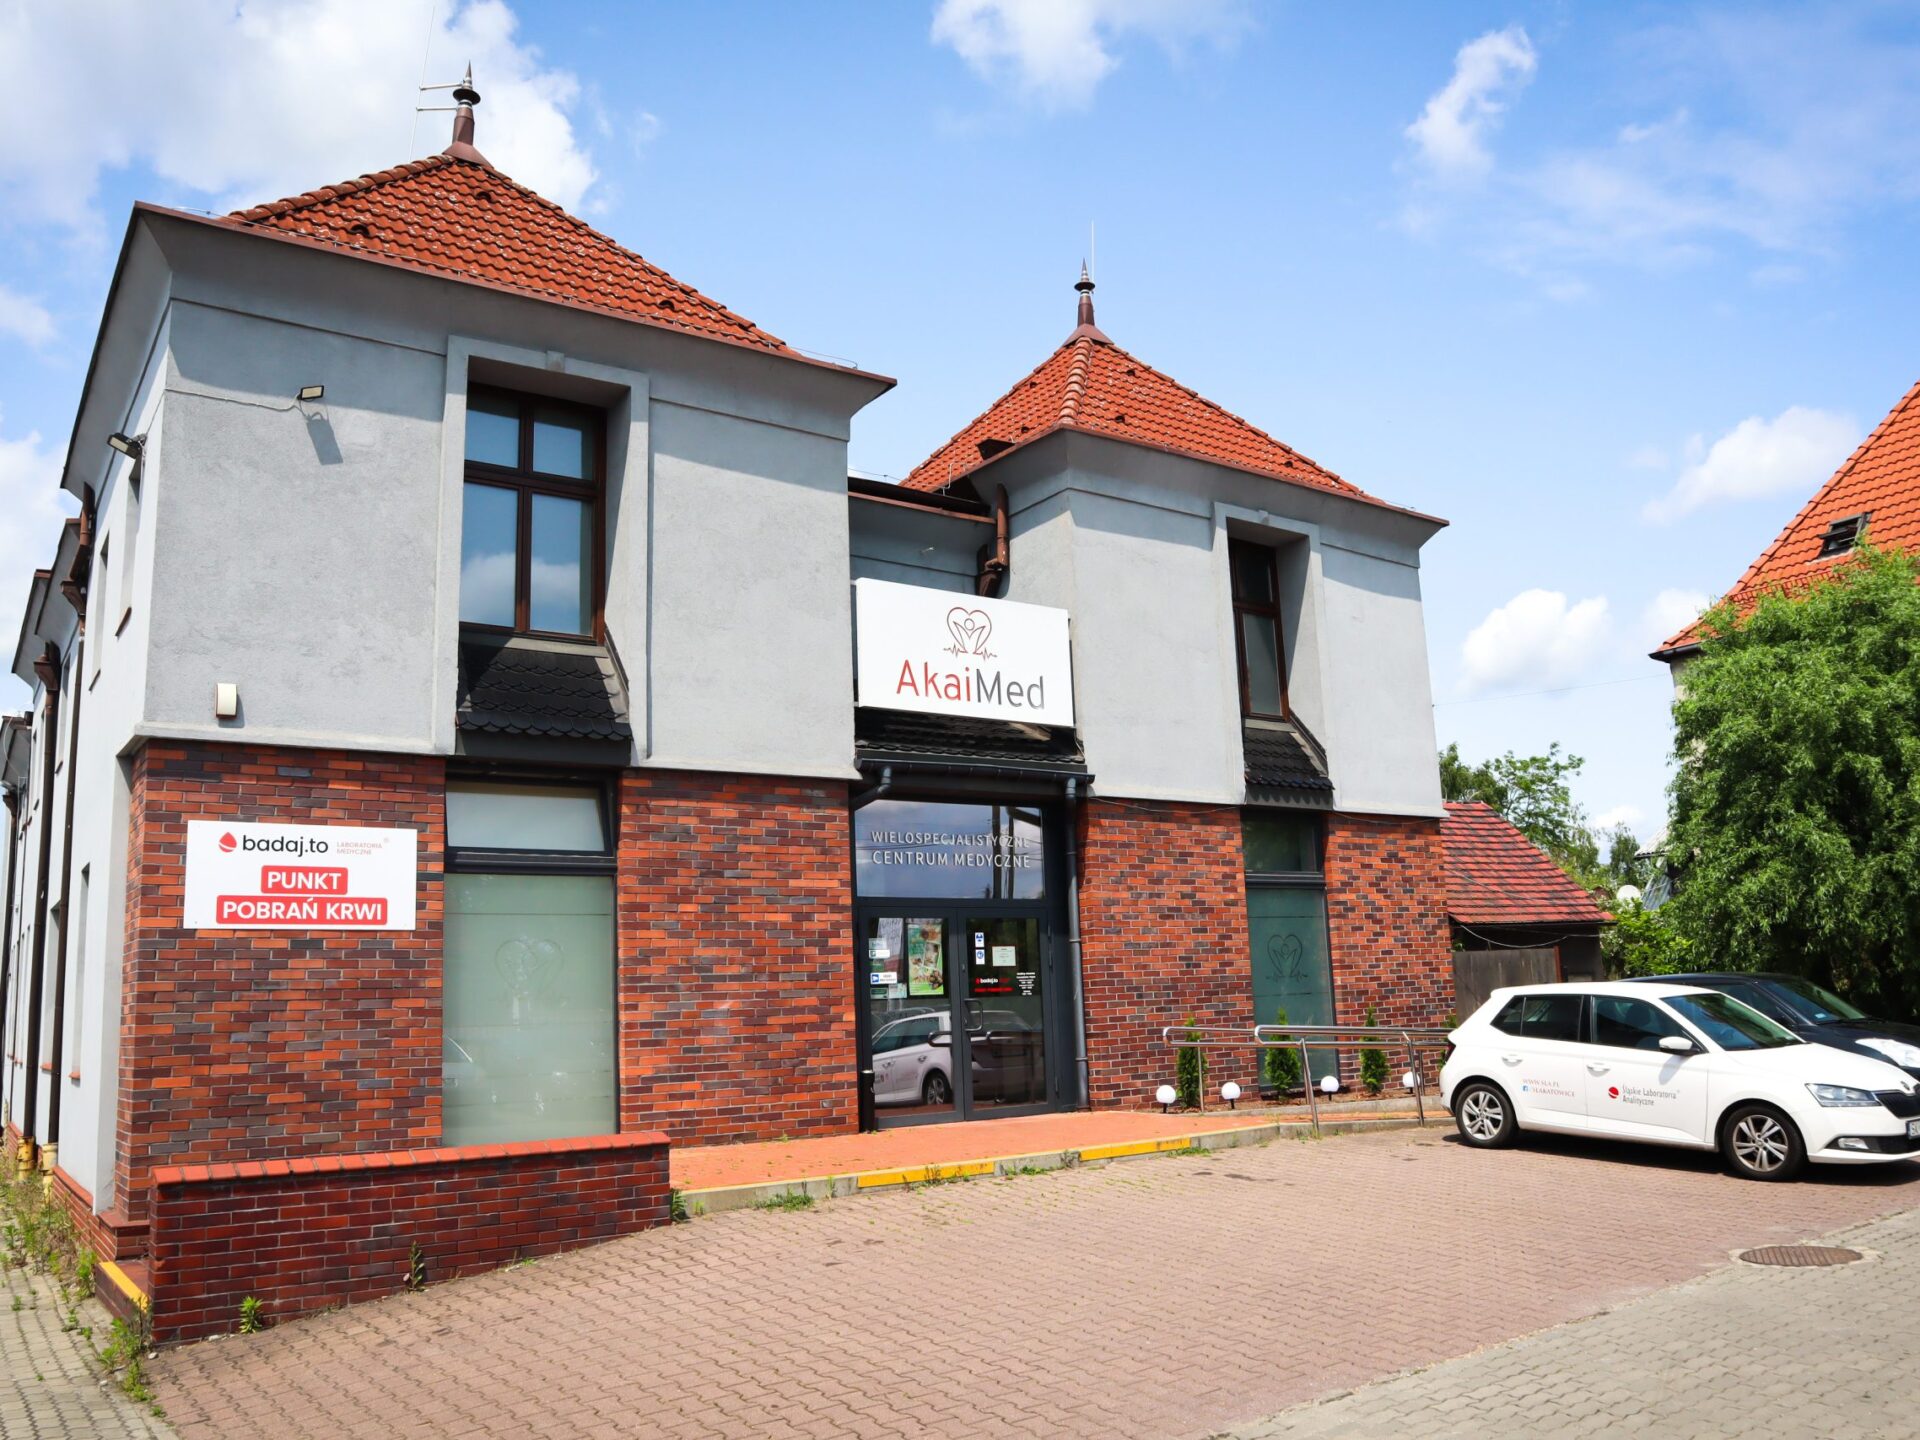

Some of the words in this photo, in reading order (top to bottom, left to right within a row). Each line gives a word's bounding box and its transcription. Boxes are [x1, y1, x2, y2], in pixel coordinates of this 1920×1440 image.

[896, 659, 1045, 710] AkaiMed
[242, 834, 329, 857] badaj.to
[336, 841, 383, 849] LABORATORIA
[871, 831, 1030, 848] WIELOSPECJALISTYCZNE
[872, 850, 948, 866] CENTRUM
[954, 853, 1031, 868] MEDYCZNE
[267, 871, 342, 890] PUNKT
[222, 897, 318, 920] POBRAŃ
[326, 902, 382, 920] KRWI
[1643, 1088, 1677, 1099] Laboratoria
